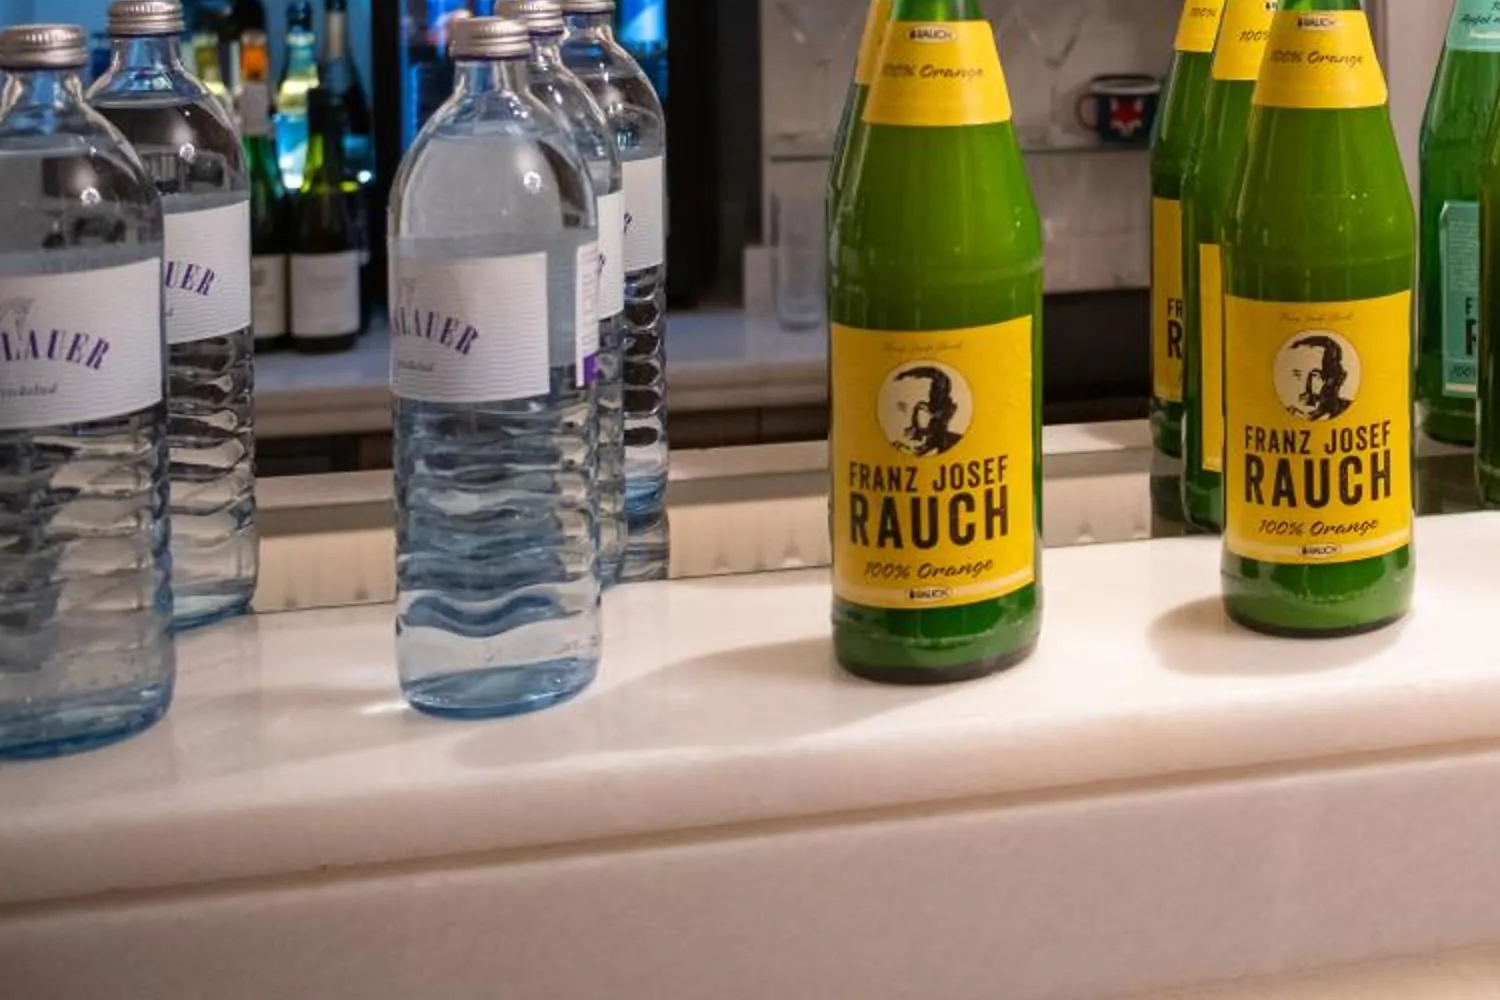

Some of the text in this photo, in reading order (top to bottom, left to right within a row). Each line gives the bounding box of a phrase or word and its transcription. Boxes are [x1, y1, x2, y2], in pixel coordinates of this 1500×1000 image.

[1244, 420, 1392, 455] FRANZ JOSEF
[849, 455, 1009, 493] FRANZ JOSEF
[1244, 449, 1392, 509] RAUCH
[850, 484, 1009, 550] RAUCH
[1258, 518, 1379, 537] 100% Orange
[863, 557, 994, 580] 100% Orange
